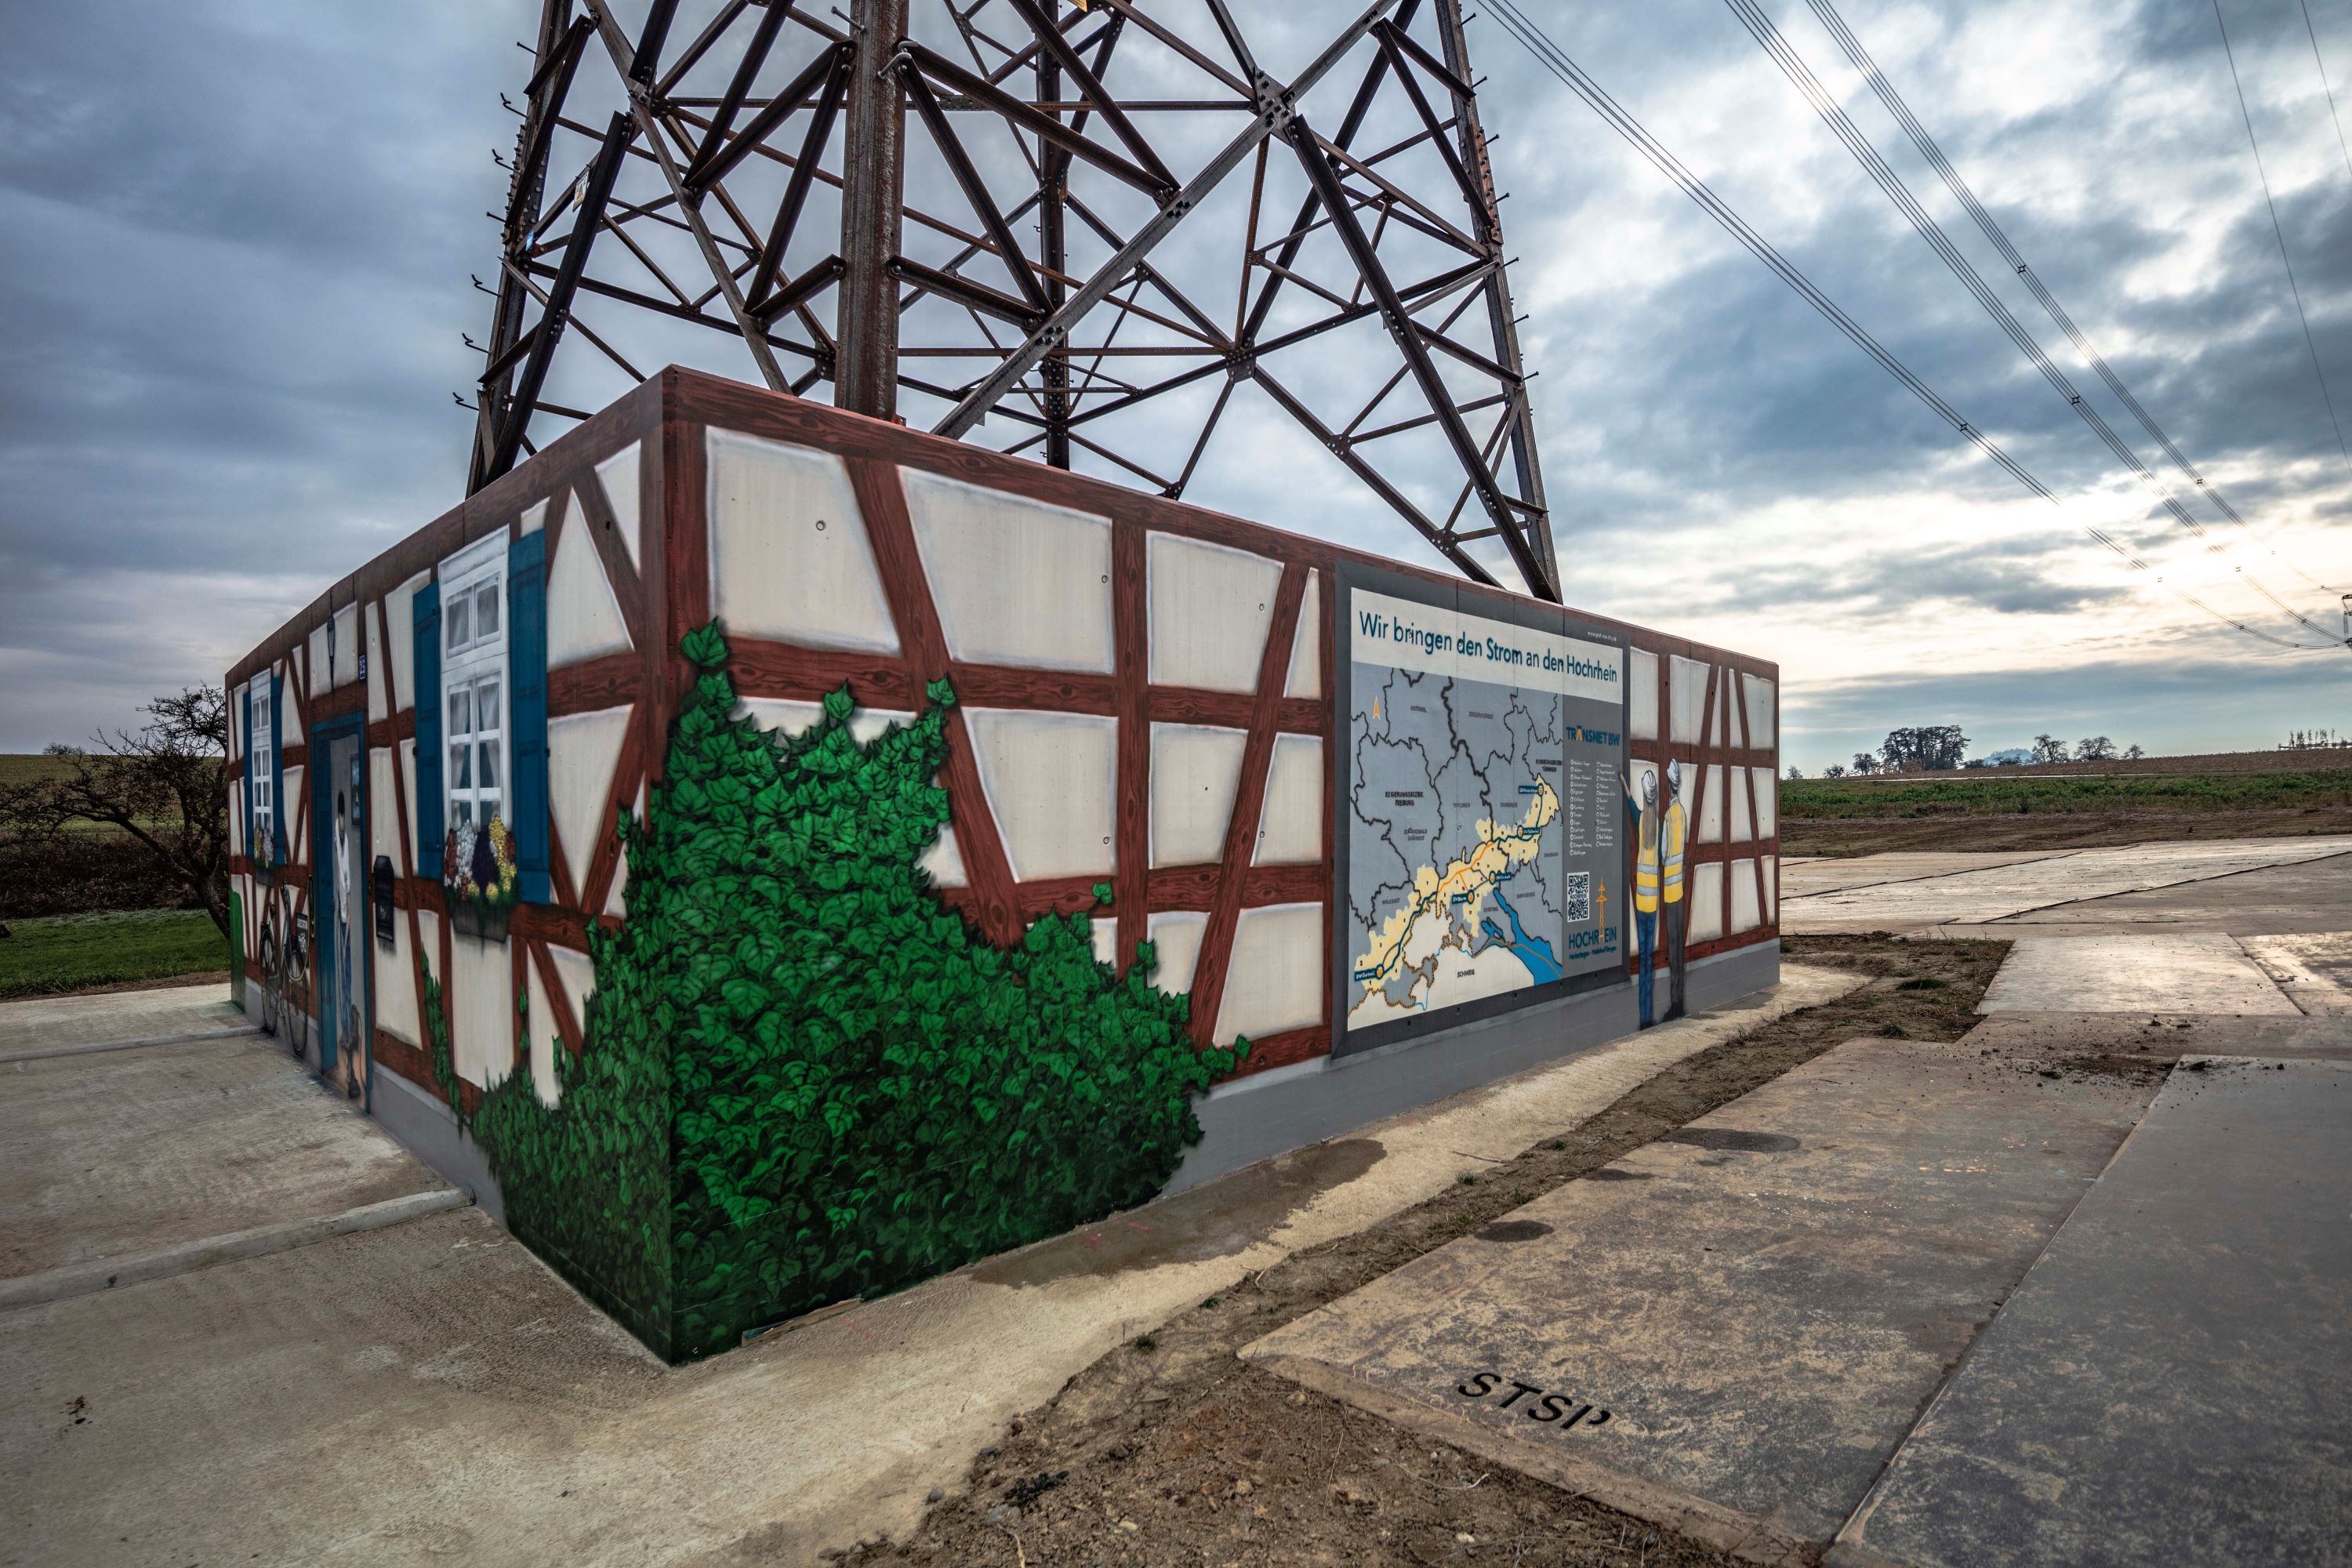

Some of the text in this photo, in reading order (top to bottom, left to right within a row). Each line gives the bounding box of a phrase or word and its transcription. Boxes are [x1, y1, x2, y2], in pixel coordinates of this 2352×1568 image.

[1359, 611, 1617, 683] Wir bringen den Strom an den Hochrhein
[1609, 732, 1620, 746] BW
[1569, 926, 1617, 949] HOCHRHEIN
[1458, 1373, 1611, 1429] STSP
